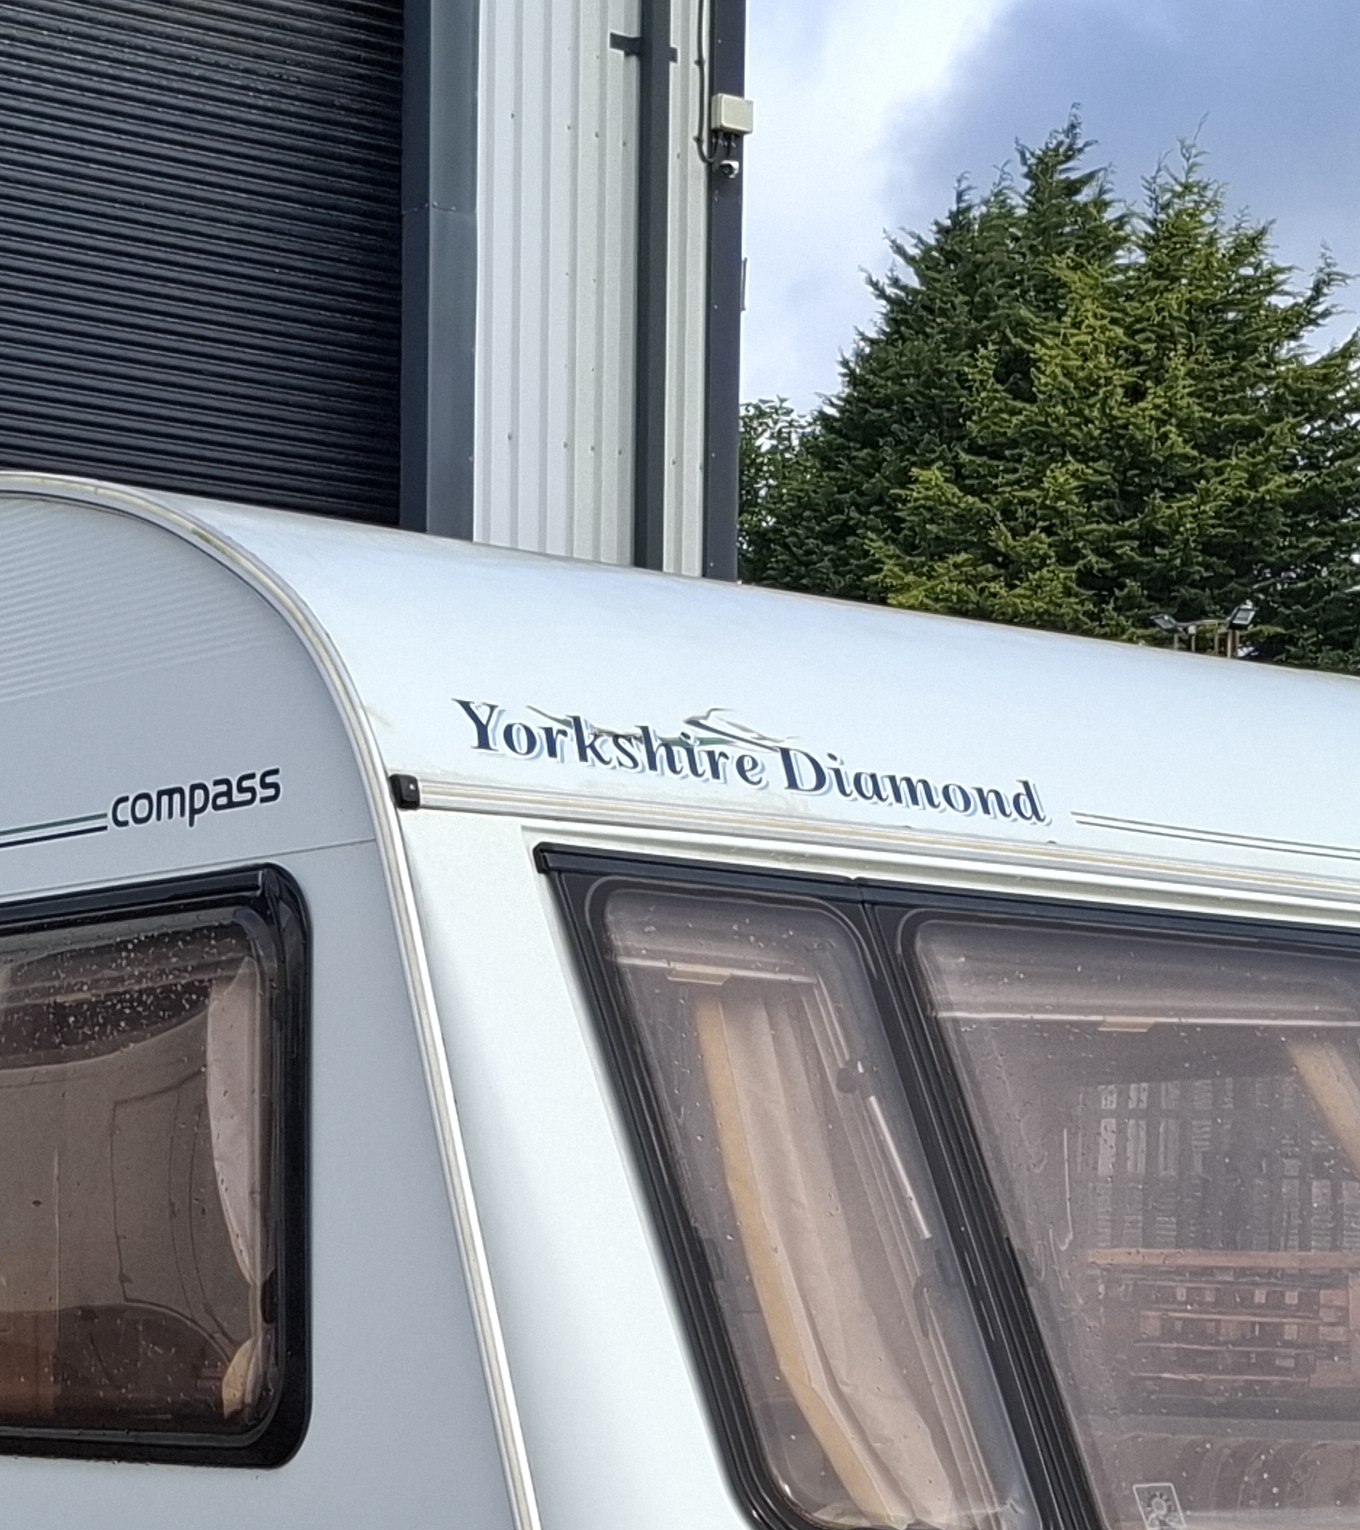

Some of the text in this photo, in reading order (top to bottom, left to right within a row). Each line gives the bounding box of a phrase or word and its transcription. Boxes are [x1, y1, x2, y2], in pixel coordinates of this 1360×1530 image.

[111, 767, 281, 828] compass
[451, 698, 1048, 825] Yorkshire Diamond
